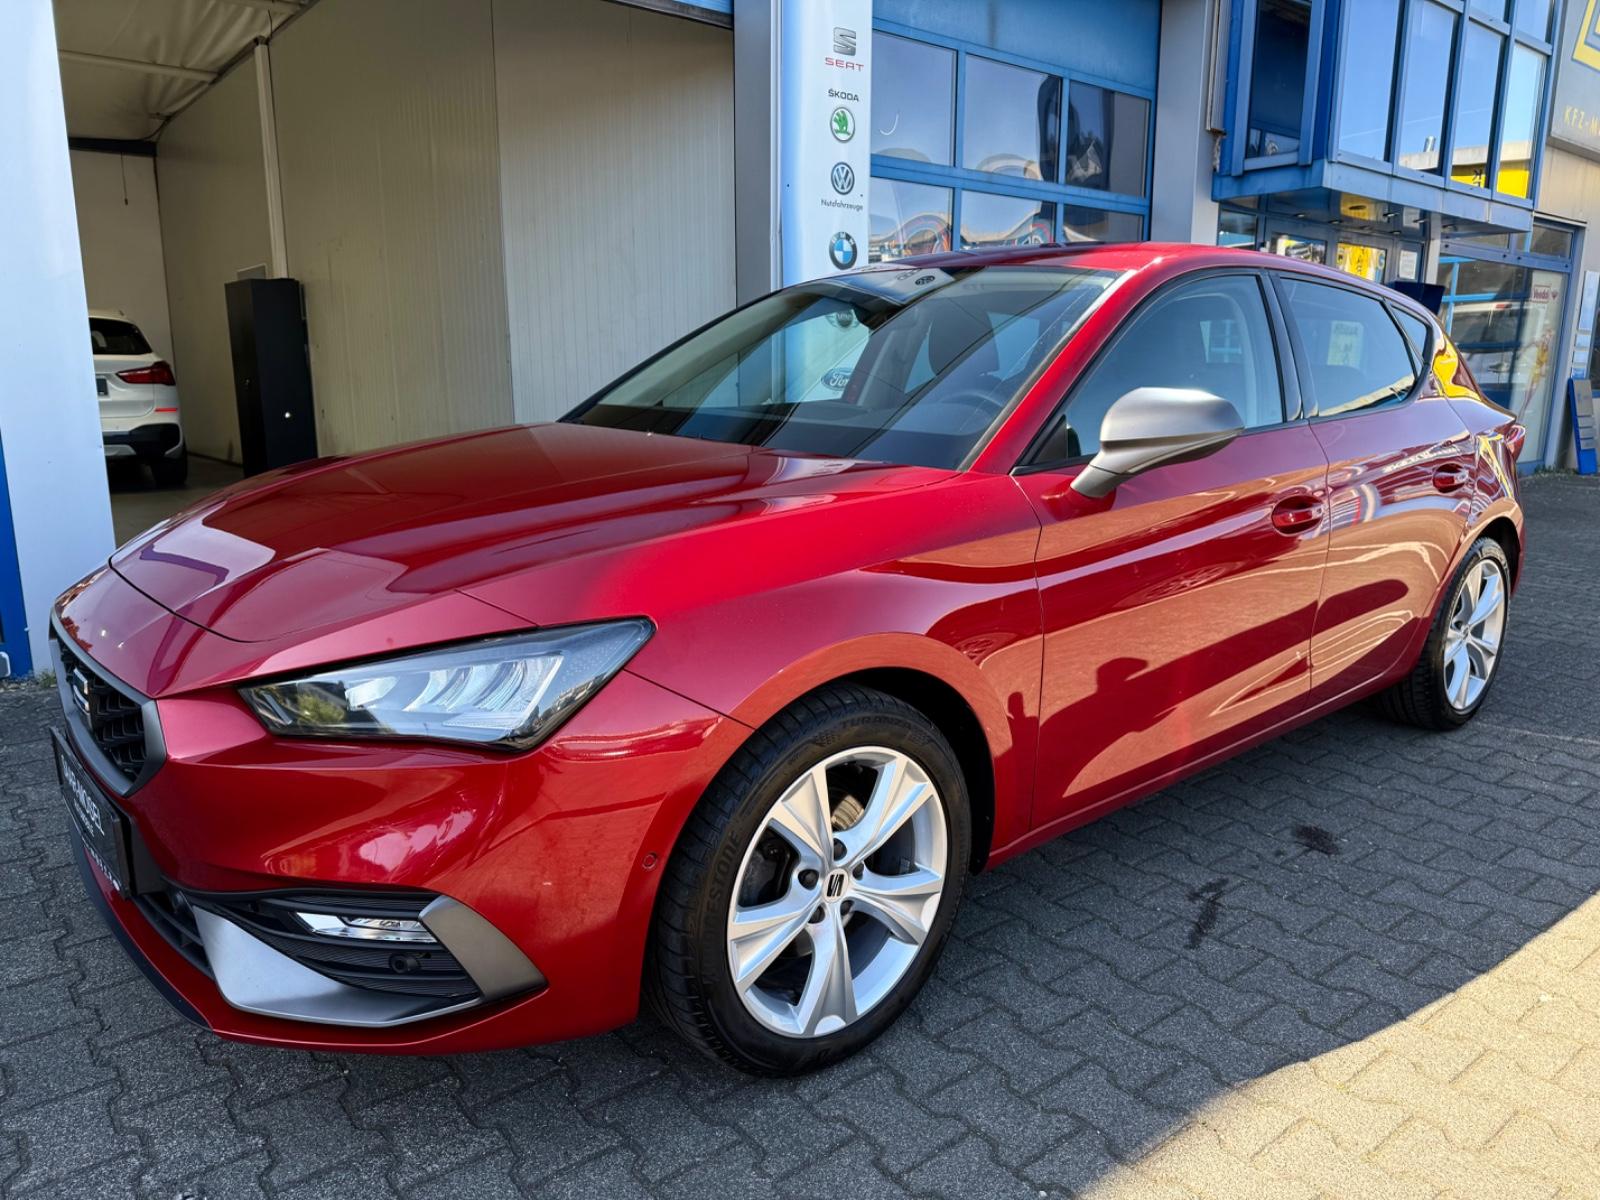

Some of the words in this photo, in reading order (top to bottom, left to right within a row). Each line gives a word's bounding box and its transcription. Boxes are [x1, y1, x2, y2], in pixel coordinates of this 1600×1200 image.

[825, 57, 864, 71] SEAT
[828, 88, 859, 102] ŠKODA
[1564, 106, 1600, 135] KFZ-M
[820, 199, 863, 211] Nutzfahrzeuge
[829, 371, 850, 387] For
